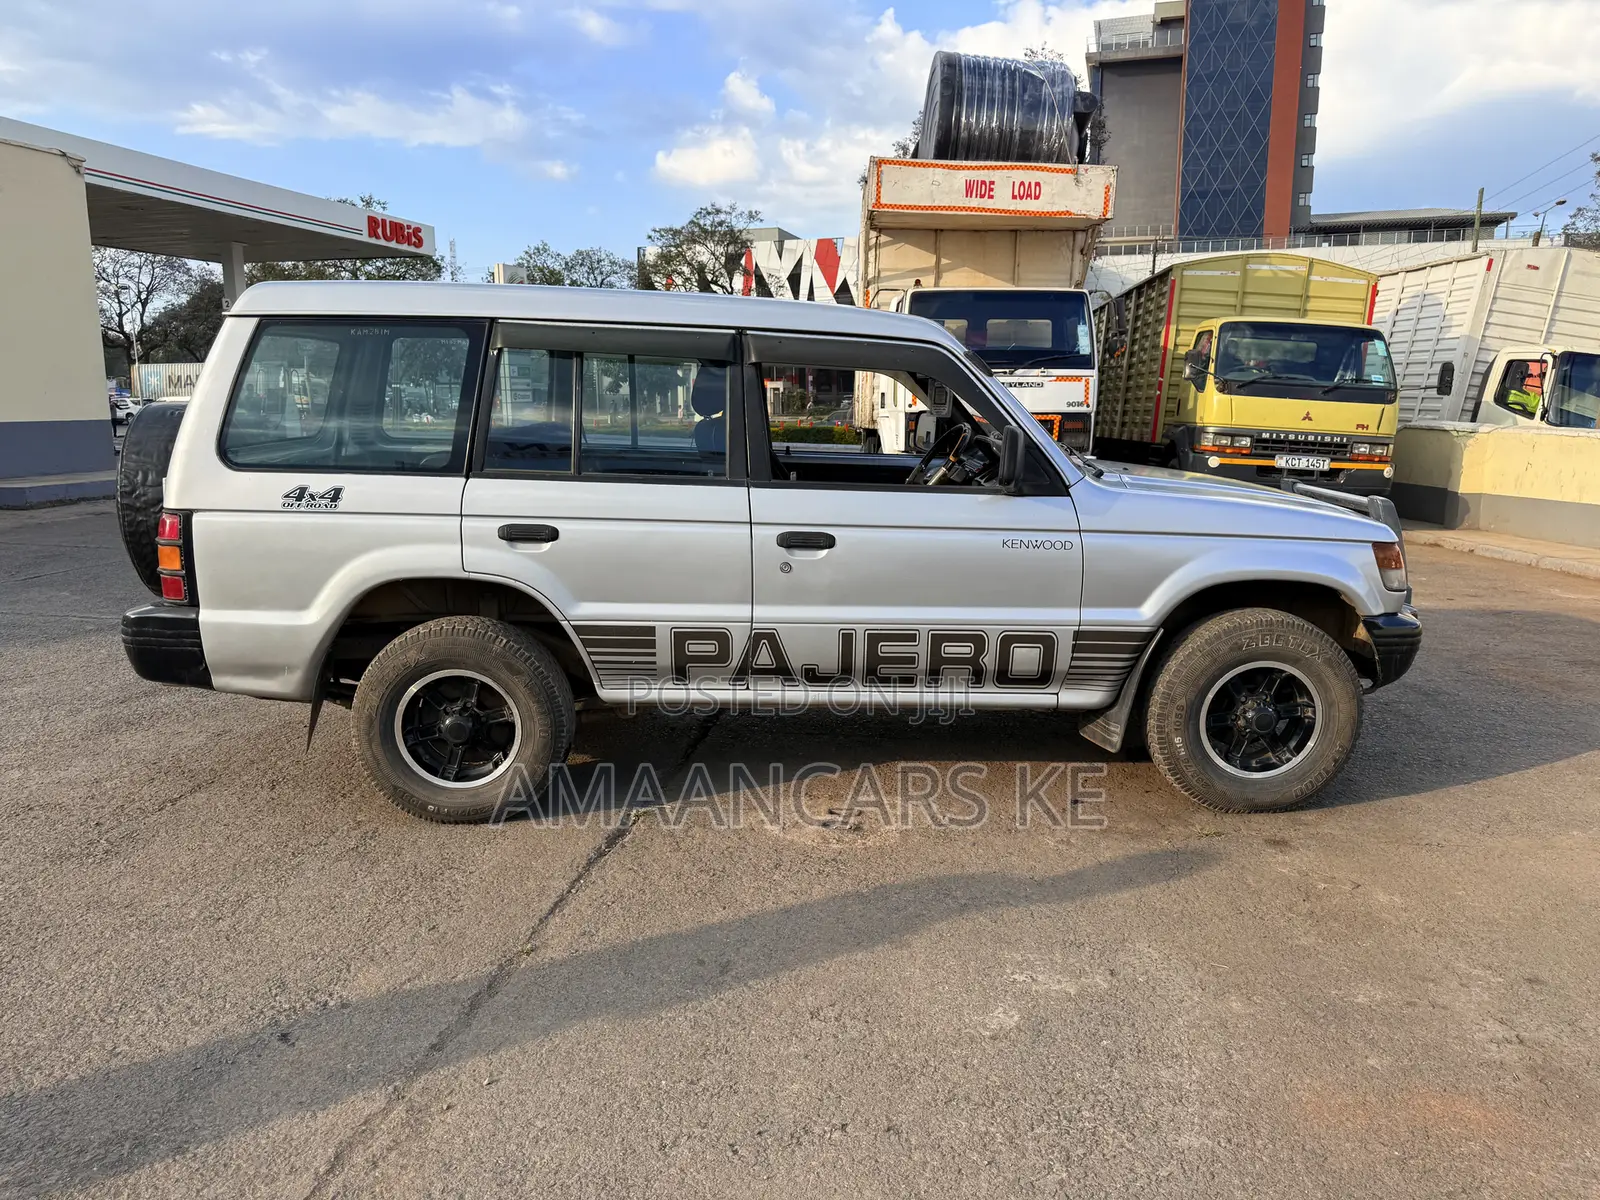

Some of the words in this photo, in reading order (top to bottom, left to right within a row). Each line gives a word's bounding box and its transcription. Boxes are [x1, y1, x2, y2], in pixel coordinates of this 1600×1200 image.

[965, 179, 995, 199] WIDE
[1011, 181, 1042, 200] LOAD
[168, 374, 199, 389] MA
[1261, 432, 1347, 443] MITSUBISHI
[1285, 457, 1302, 467] KCT
[1305, 458, 1327, 469] 145T
[1002, 538, 1074, 550] KENWOOD
[670, 627, 1059, 689] PAJERO
